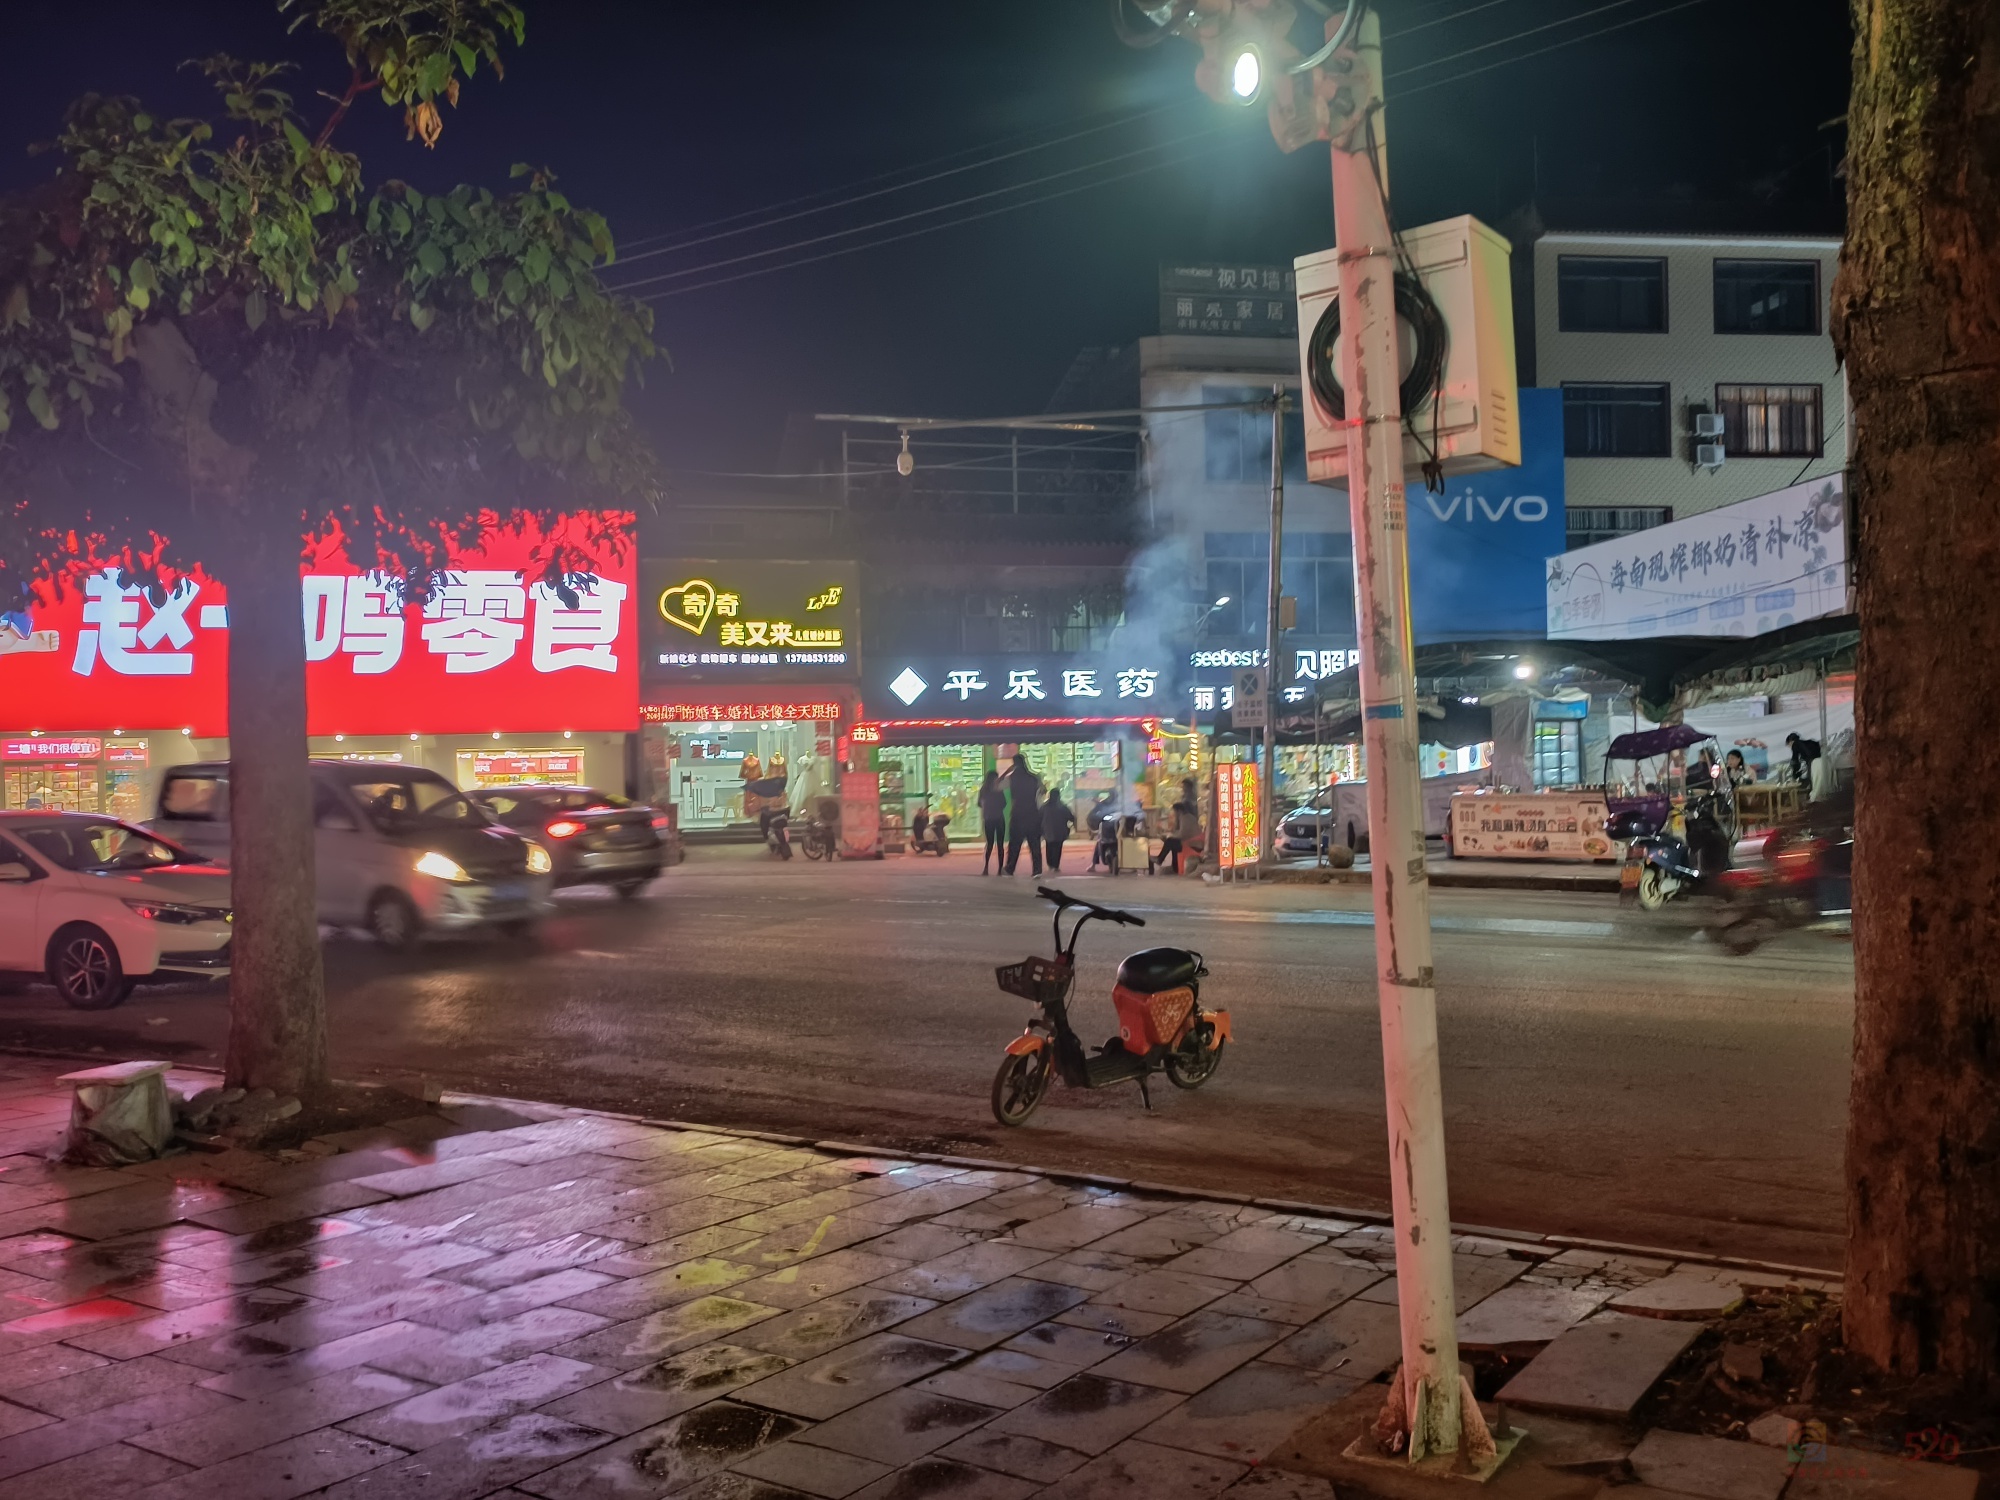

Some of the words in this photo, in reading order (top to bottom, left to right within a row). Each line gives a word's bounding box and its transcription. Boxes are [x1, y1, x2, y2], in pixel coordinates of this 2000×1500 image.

[1176, 298, 1284, 320] 丽亮家居
[1426, 487, 1548, 521] vivo
[682, 593, 741, 617] 奇奇
[72, 567, 628, 676] 赵鸣零食
[720, 621, 794, 647] 美又来
[1190, 649, 1261, 667] seebest
[942, 667, 1159, 701] 平乐医药
[1242, 764, 1257, 835] 麻辣烫
